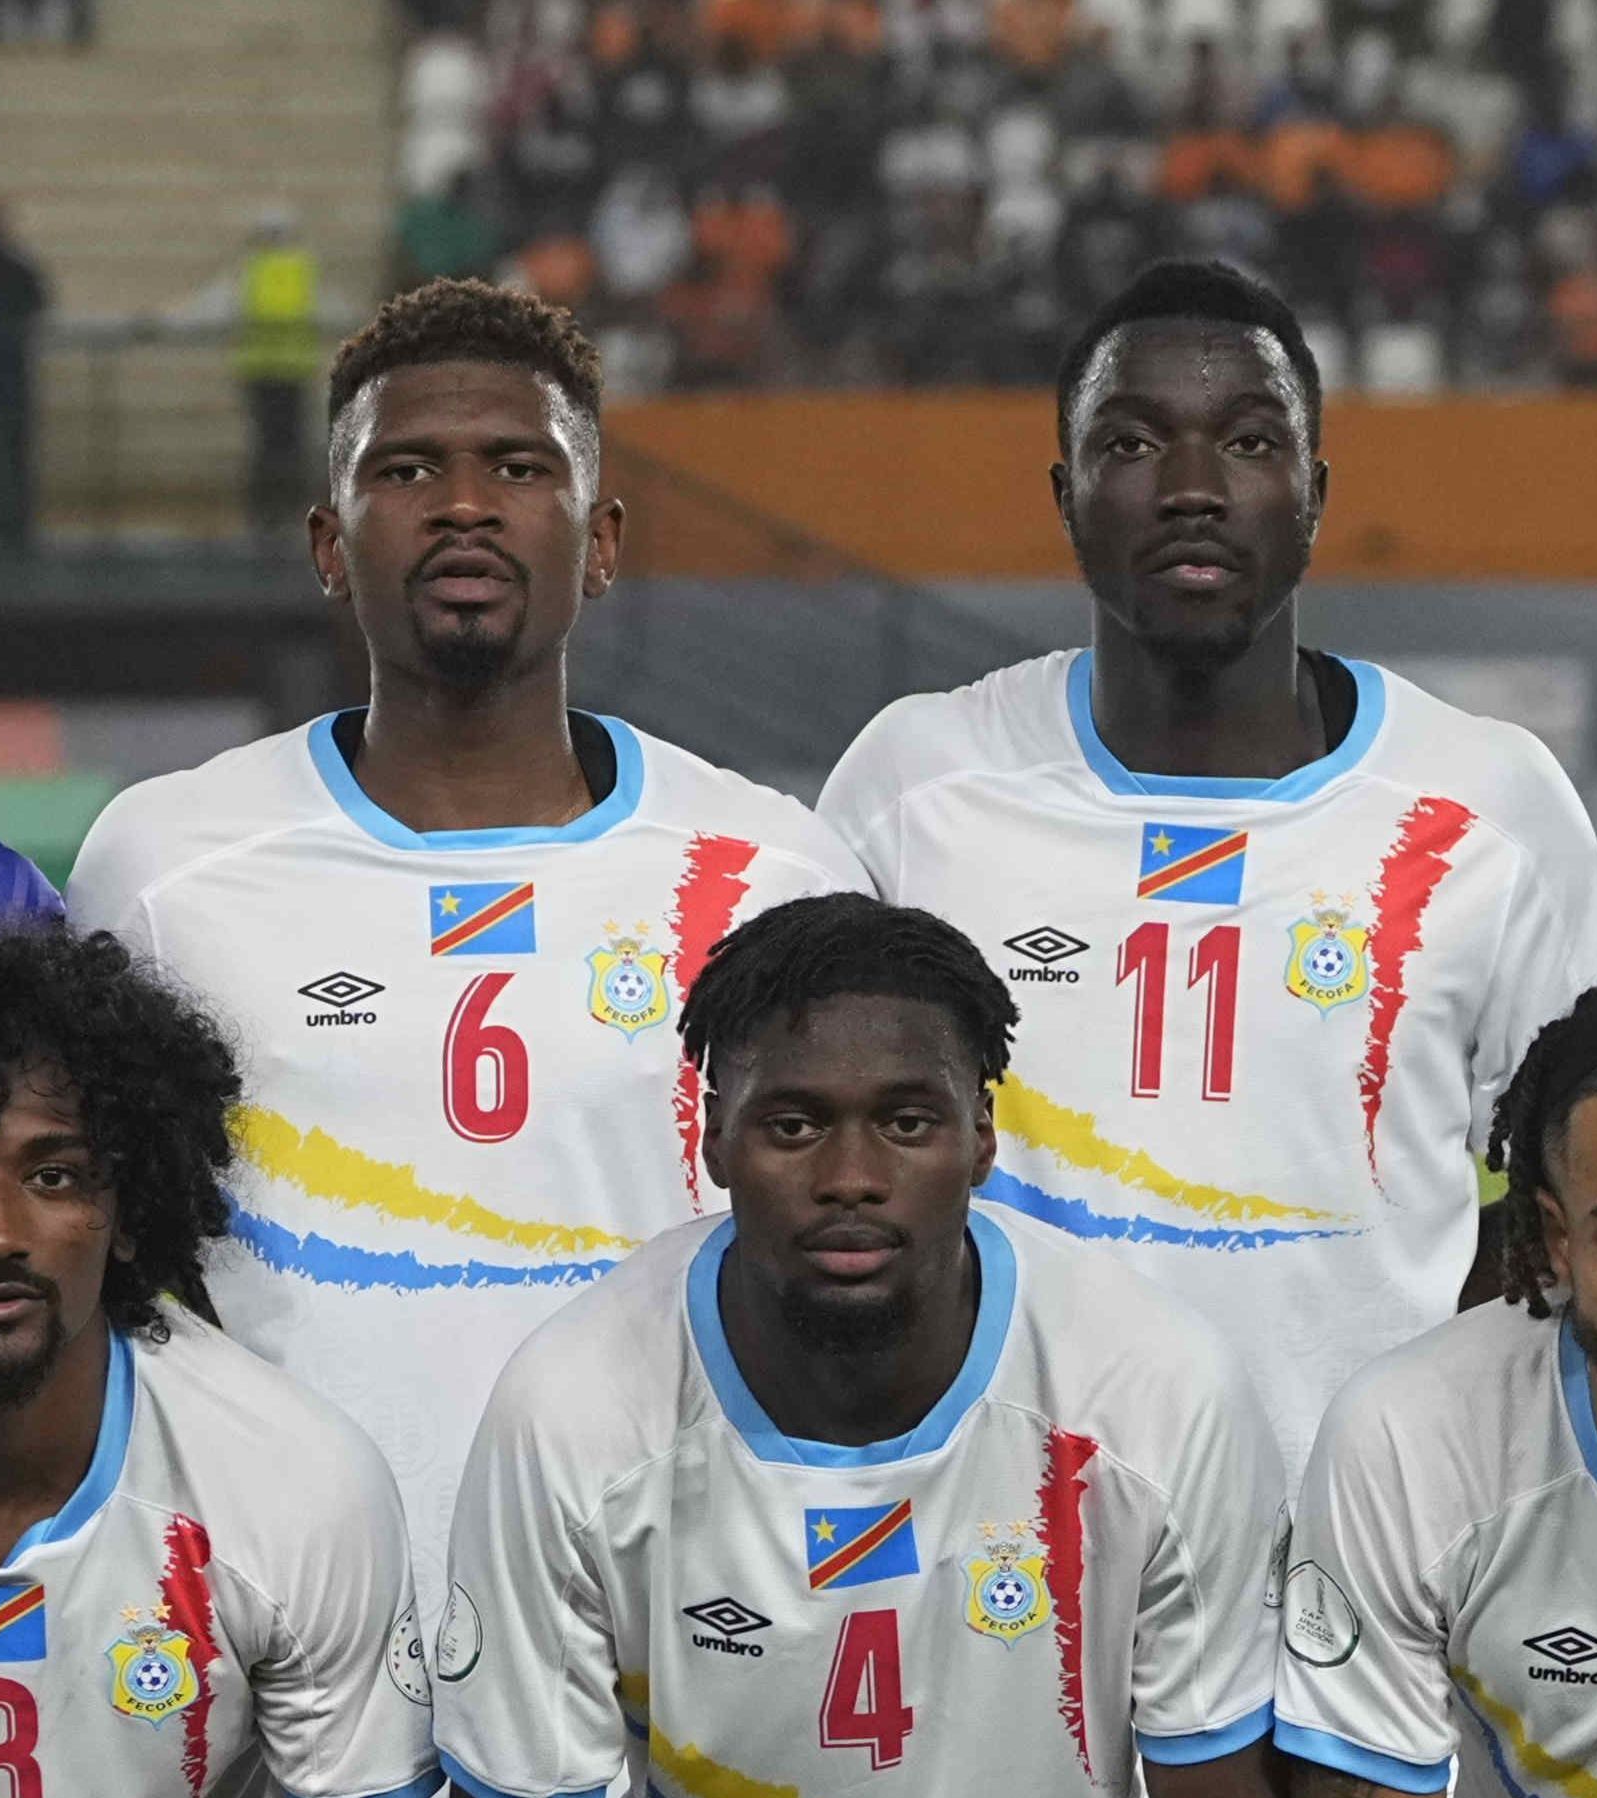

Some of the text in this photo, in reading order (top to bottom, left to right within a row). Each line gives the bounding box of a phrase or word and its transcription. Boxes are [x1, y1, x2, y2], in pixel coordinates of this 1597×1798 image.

[1008, 965, 1081, 983] umbro
[1299, 979, 1355, 999] FECOFA
[306, 1010, 378, 1028] umbro
[602, 1005, 655, 1024] FECOFA
[1117, 922, 1241, 1102] 11
[442, 972, 530, 1144] 6
[980, 1612, 1038, 1631] FECOFA
[692, 1634, 765, 1658] umbro
[819, 1609, 914, 1771] 4
[126, 1692, 185, 1712] FECOFA
